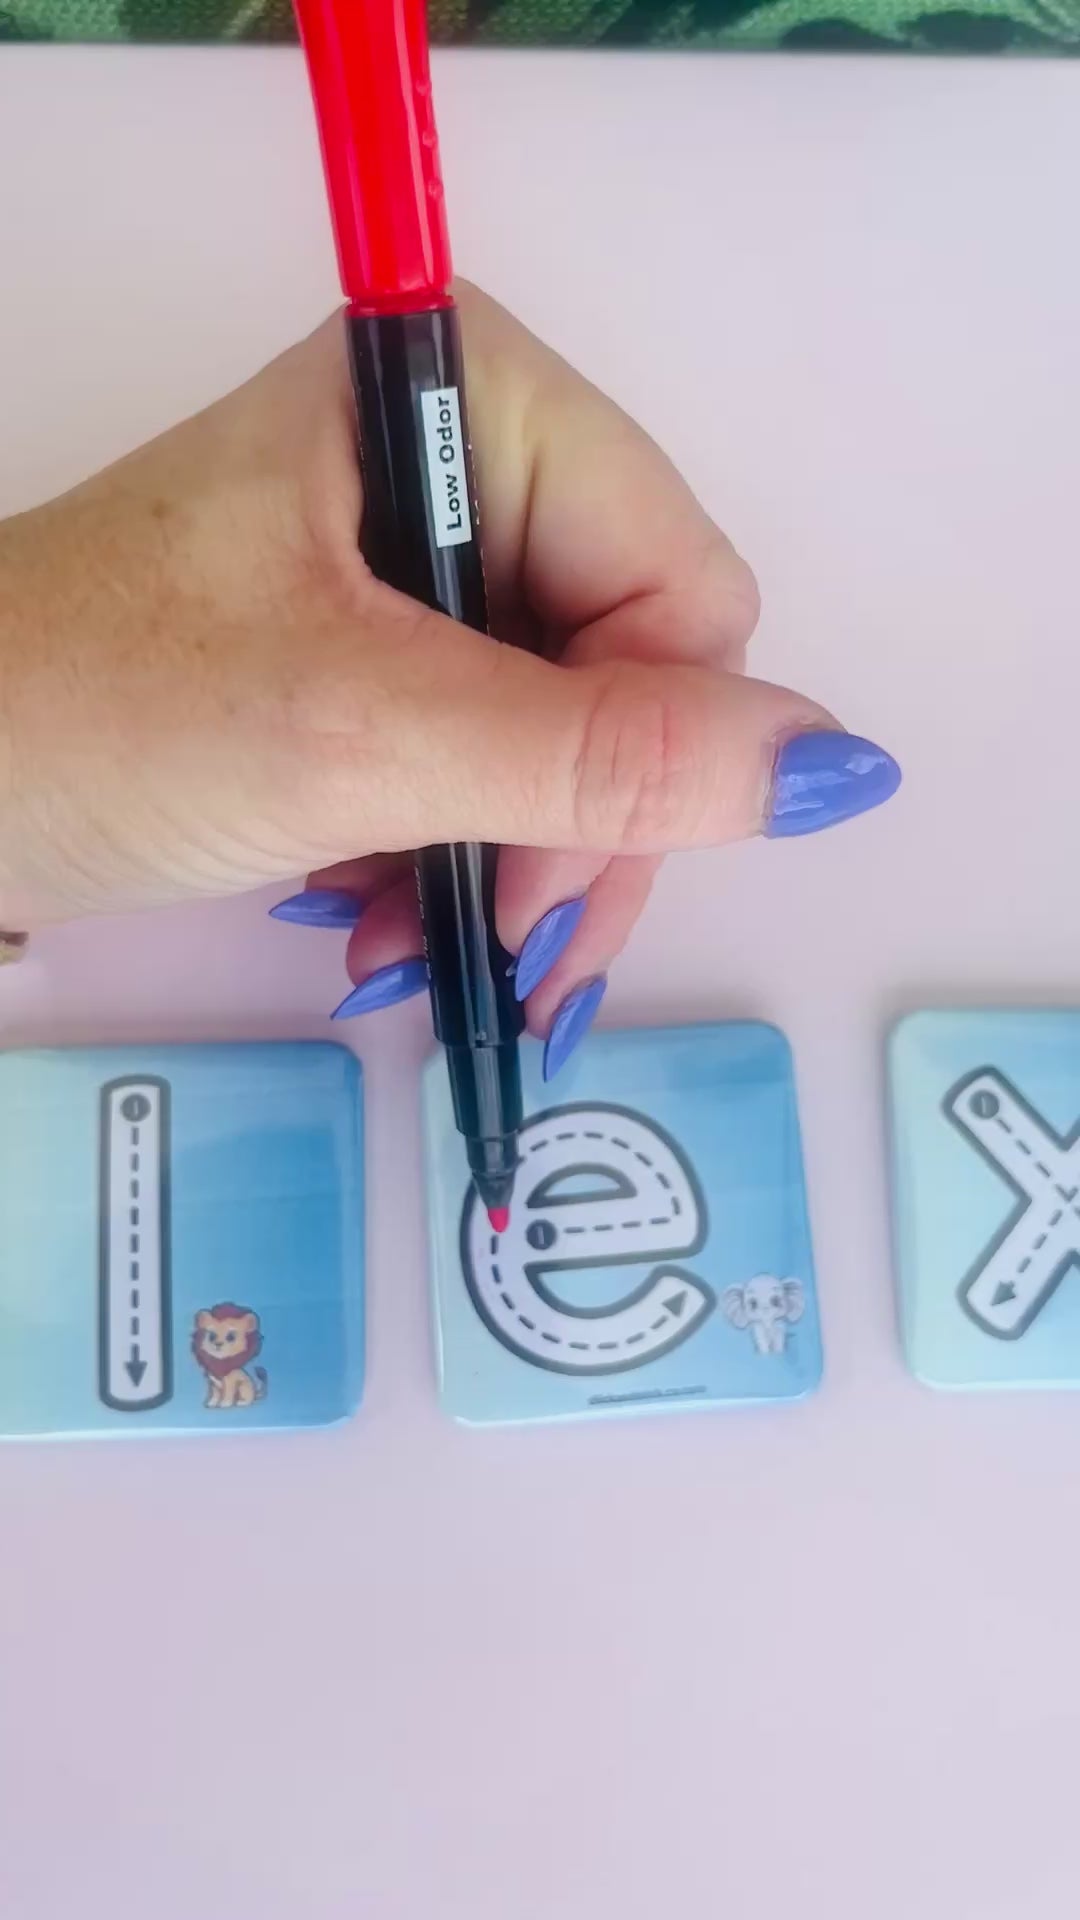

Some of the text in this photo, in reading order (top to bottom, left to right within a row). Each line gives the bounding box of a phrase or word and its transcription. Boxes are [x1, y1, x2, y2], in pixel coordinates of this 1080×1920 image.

[437, 396, 462, 531] Low Odor
[460, 1101, 717, 1377] e
